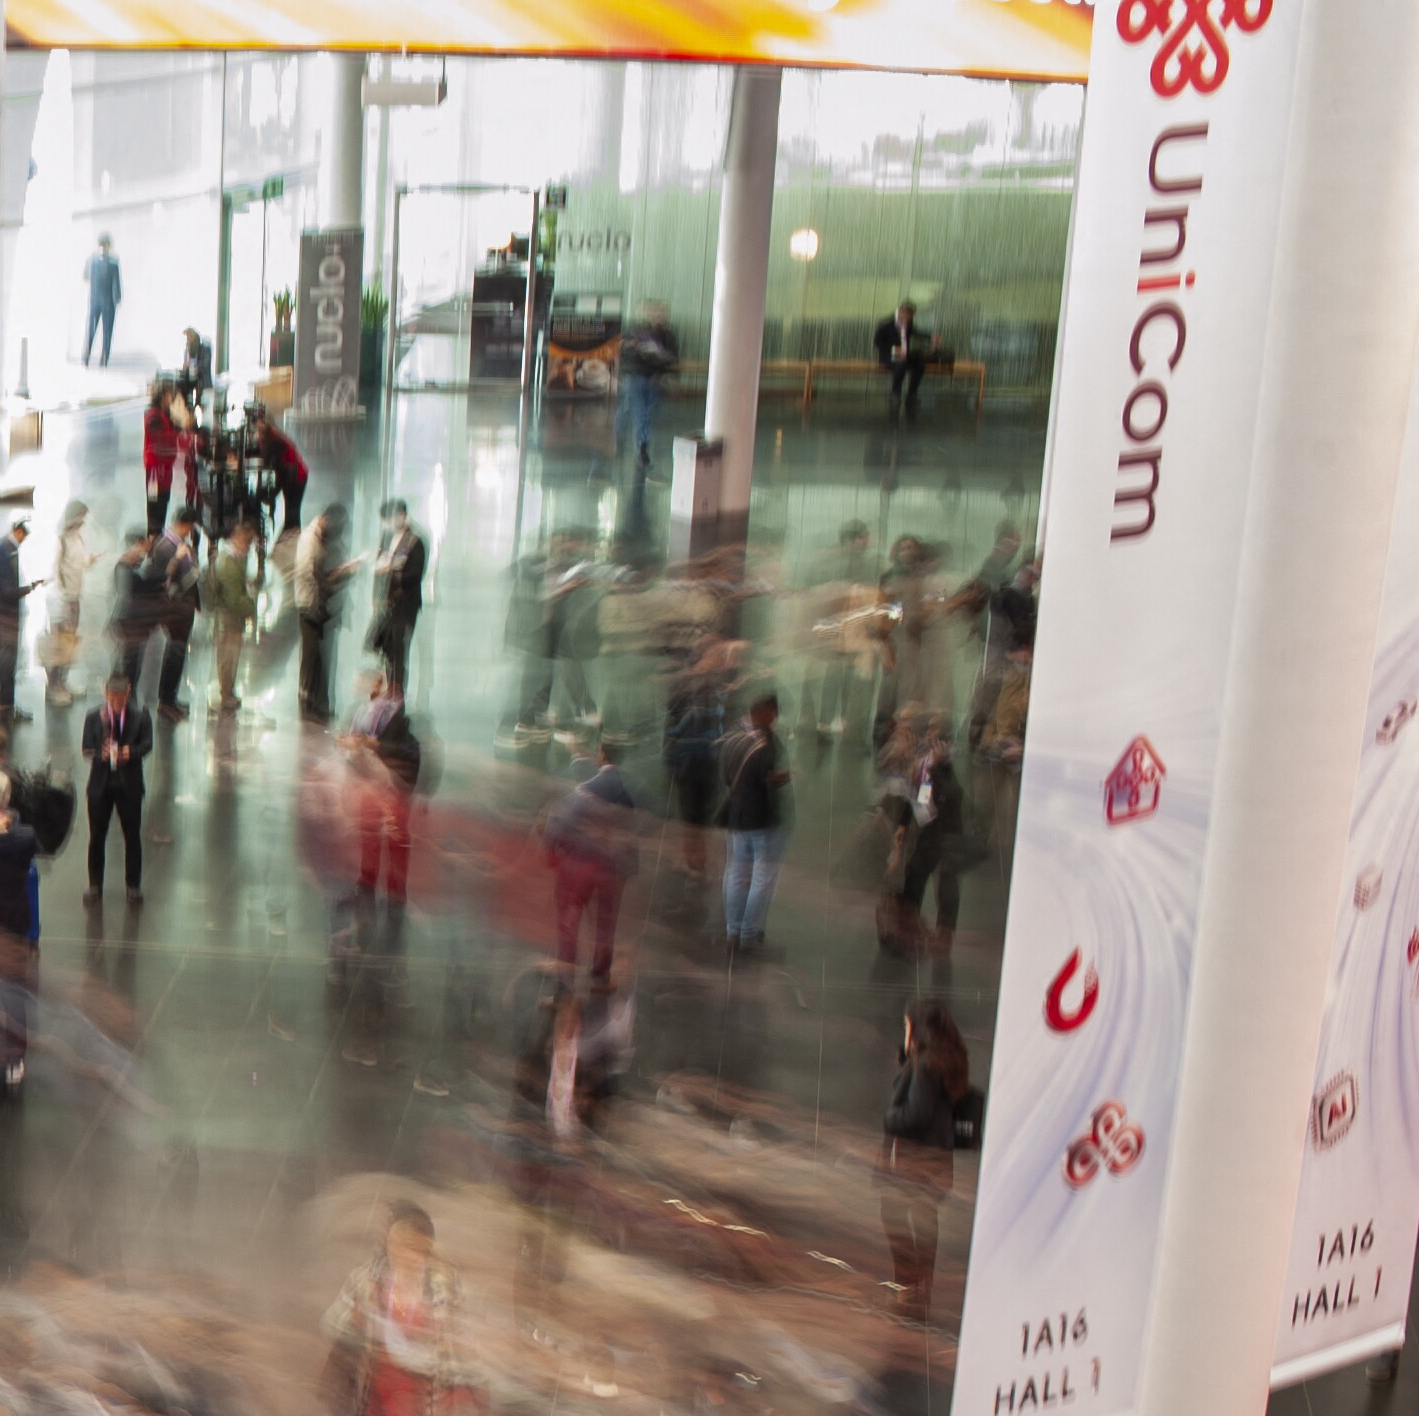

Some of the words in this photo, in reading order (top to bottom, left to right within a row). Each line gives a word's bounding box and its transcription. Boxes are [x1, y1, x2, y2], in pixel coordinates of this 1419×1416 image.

[1317, 1218, 1375, 1270] 1A16
[1292, 1275, 1360, 1331] HALL
[1374, 1265, 1382, 1300] 1
[1022, 1306, 1089, 1358] 1A16
[1092, 1357, 1102, 1397] 1
